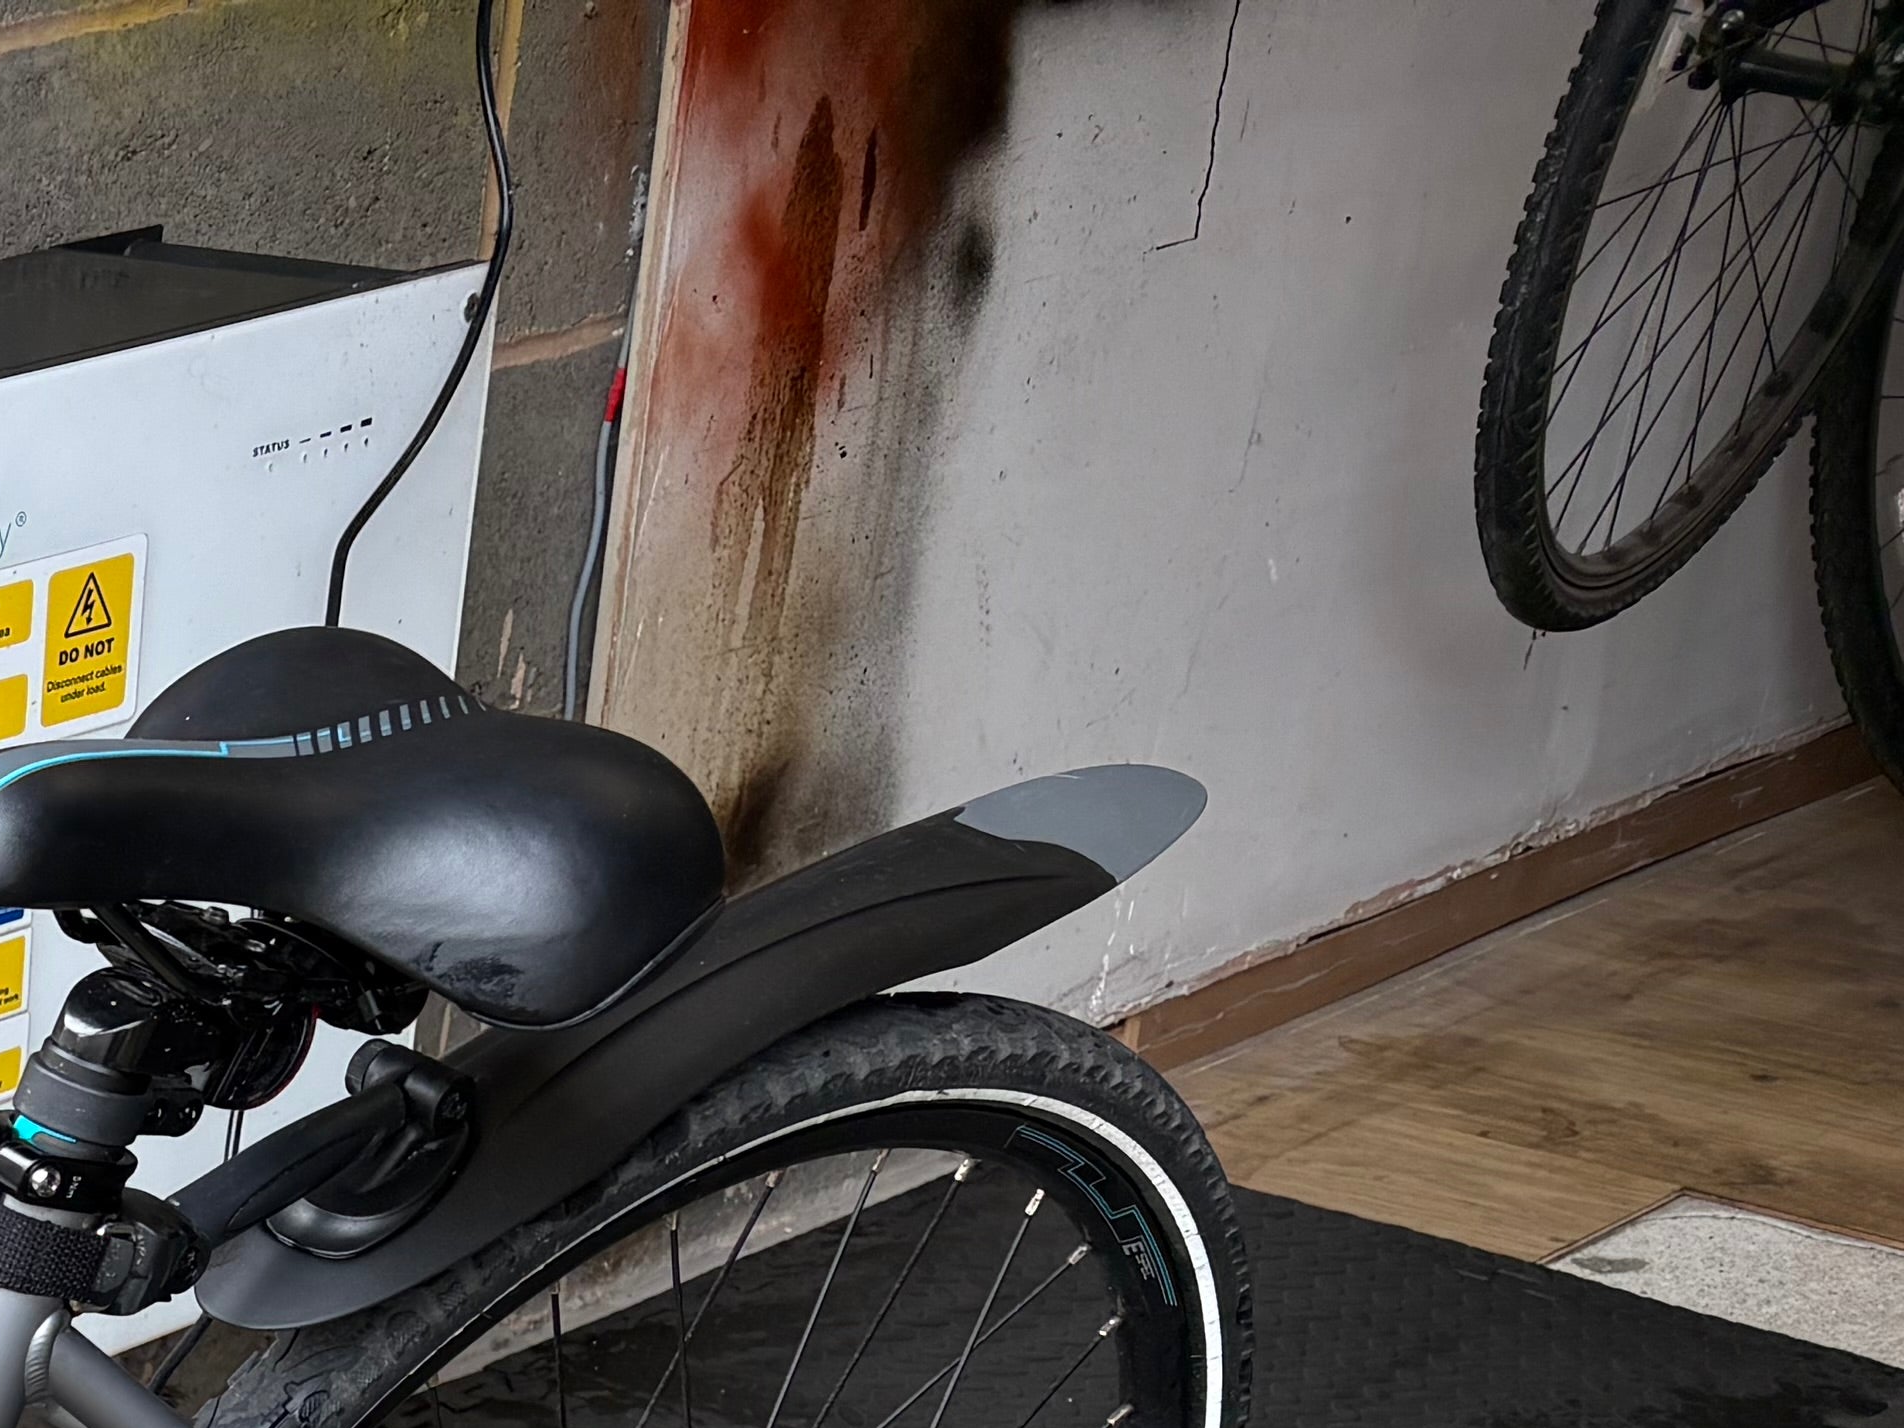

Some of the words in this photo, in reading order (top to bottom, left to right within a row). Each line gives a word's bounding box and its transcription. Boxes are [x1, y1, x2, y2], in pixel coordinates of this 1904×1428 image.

[251, 439, 290, 458] STATUS
[58, 649, 80, 666] DO
[83, 637, 115, 661] NOT
[46, 672, 94, 693] Disconnect
